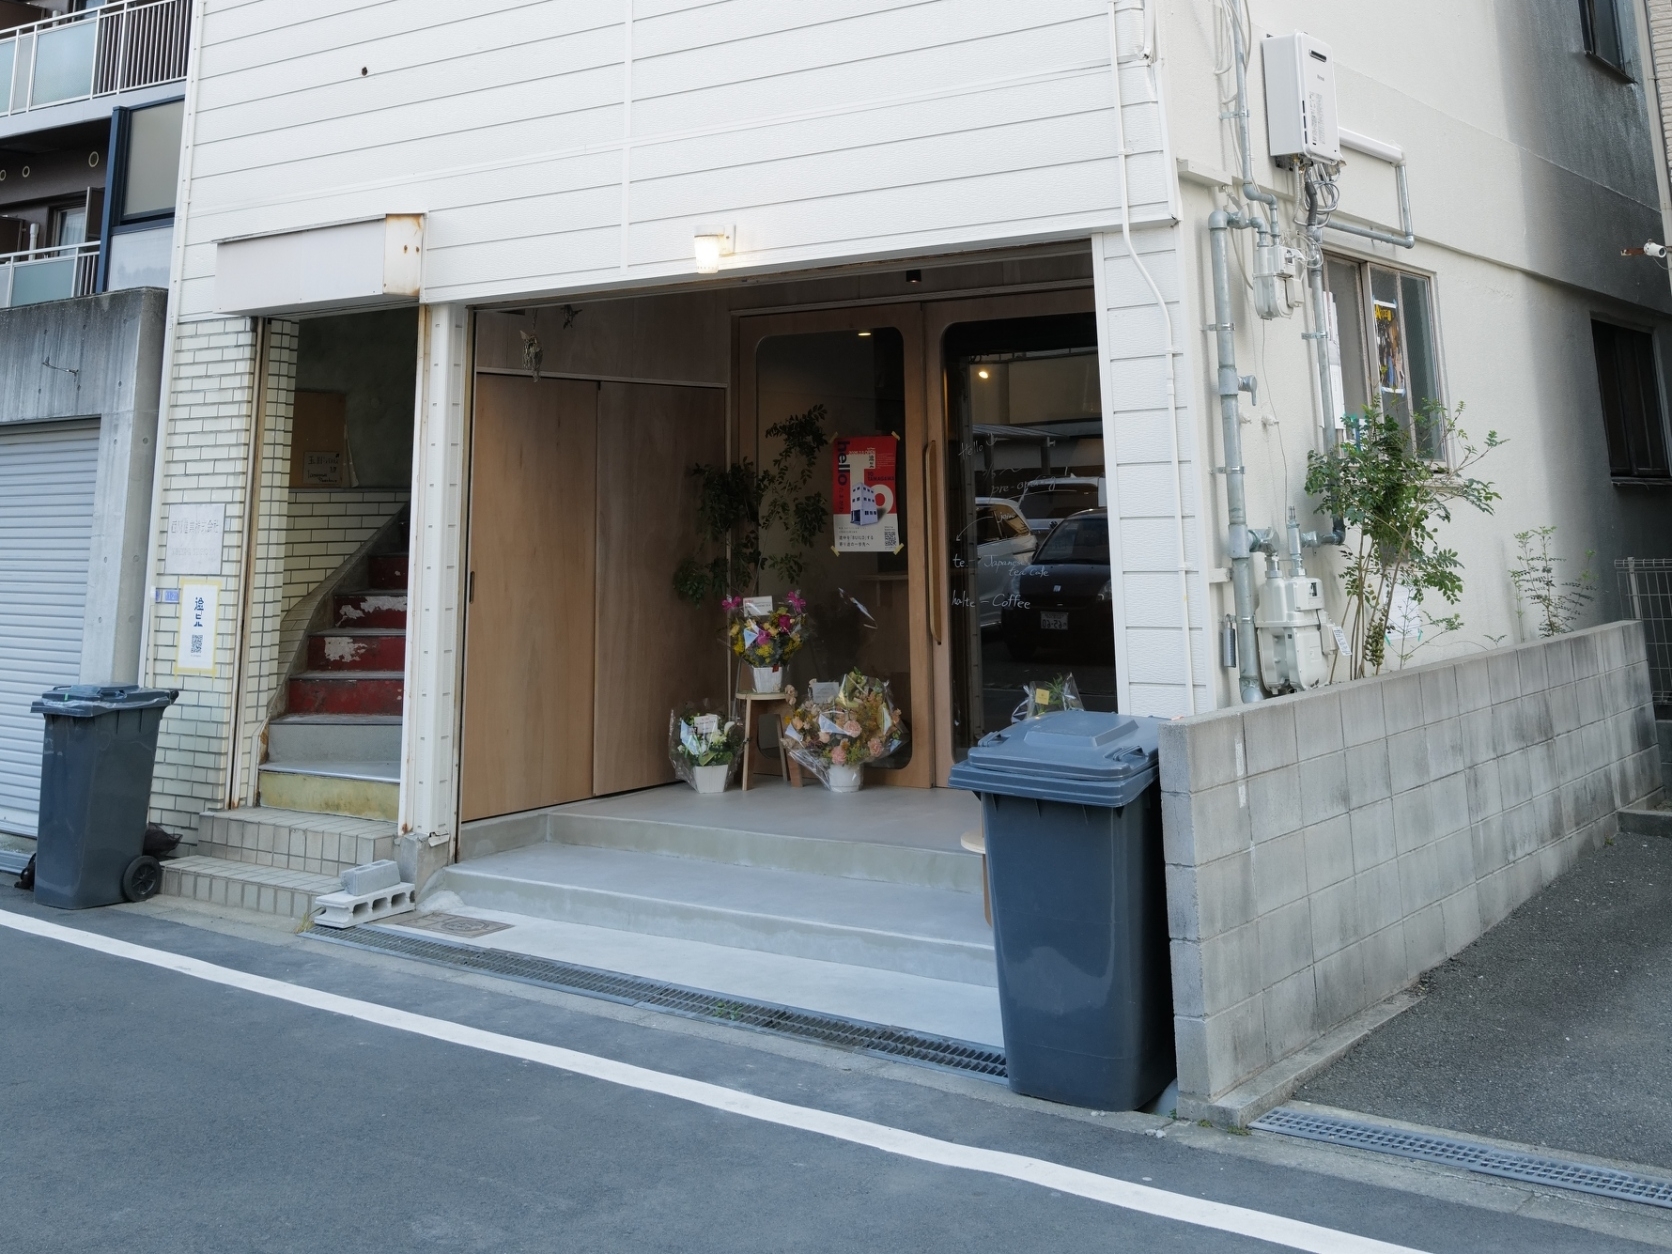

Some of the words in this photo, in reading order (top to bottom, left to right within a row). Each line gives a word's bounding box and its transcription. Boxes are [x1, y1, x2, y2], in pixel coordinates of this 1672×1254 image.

[958, 440, 984, 459] Hello
[838, 441, 850, 486] hello
[992, 593, 1031, 610] Coffee
